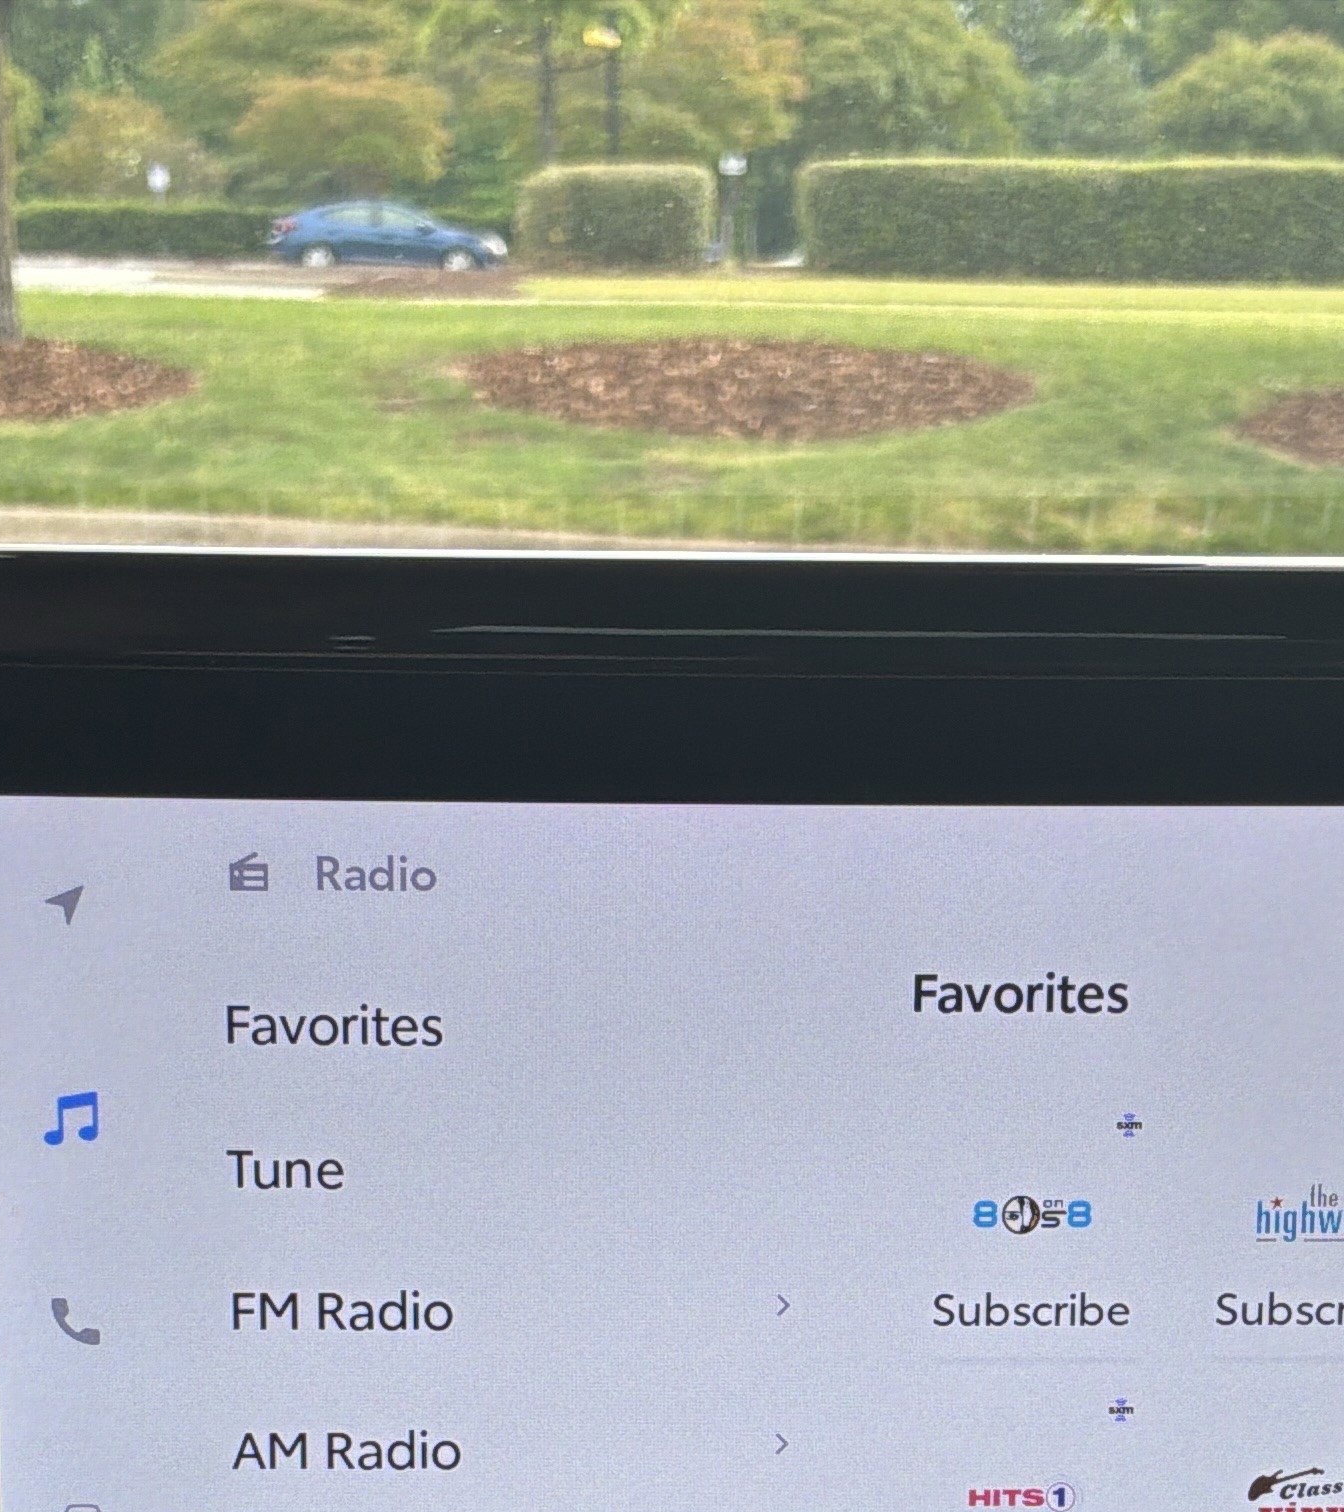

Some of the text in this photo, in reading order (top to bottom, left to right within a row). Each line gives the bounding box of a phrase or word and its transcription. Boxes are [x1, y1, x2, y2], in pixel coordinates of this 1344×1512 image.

[316, 854, 438, 892] Radio
[913, 971, 1129, 1014] Favorites
[226, 1003, 444, 1047] Favorites
[226, 1149, 345, 1191] Tune
[1310, 1183, 1339, 1208] the
[232, 1289, 454, 1332] FM Radio
[933, 1291, 1130, 1327] Subscribe
[232, 1429, 462, 1471] AM Radio
